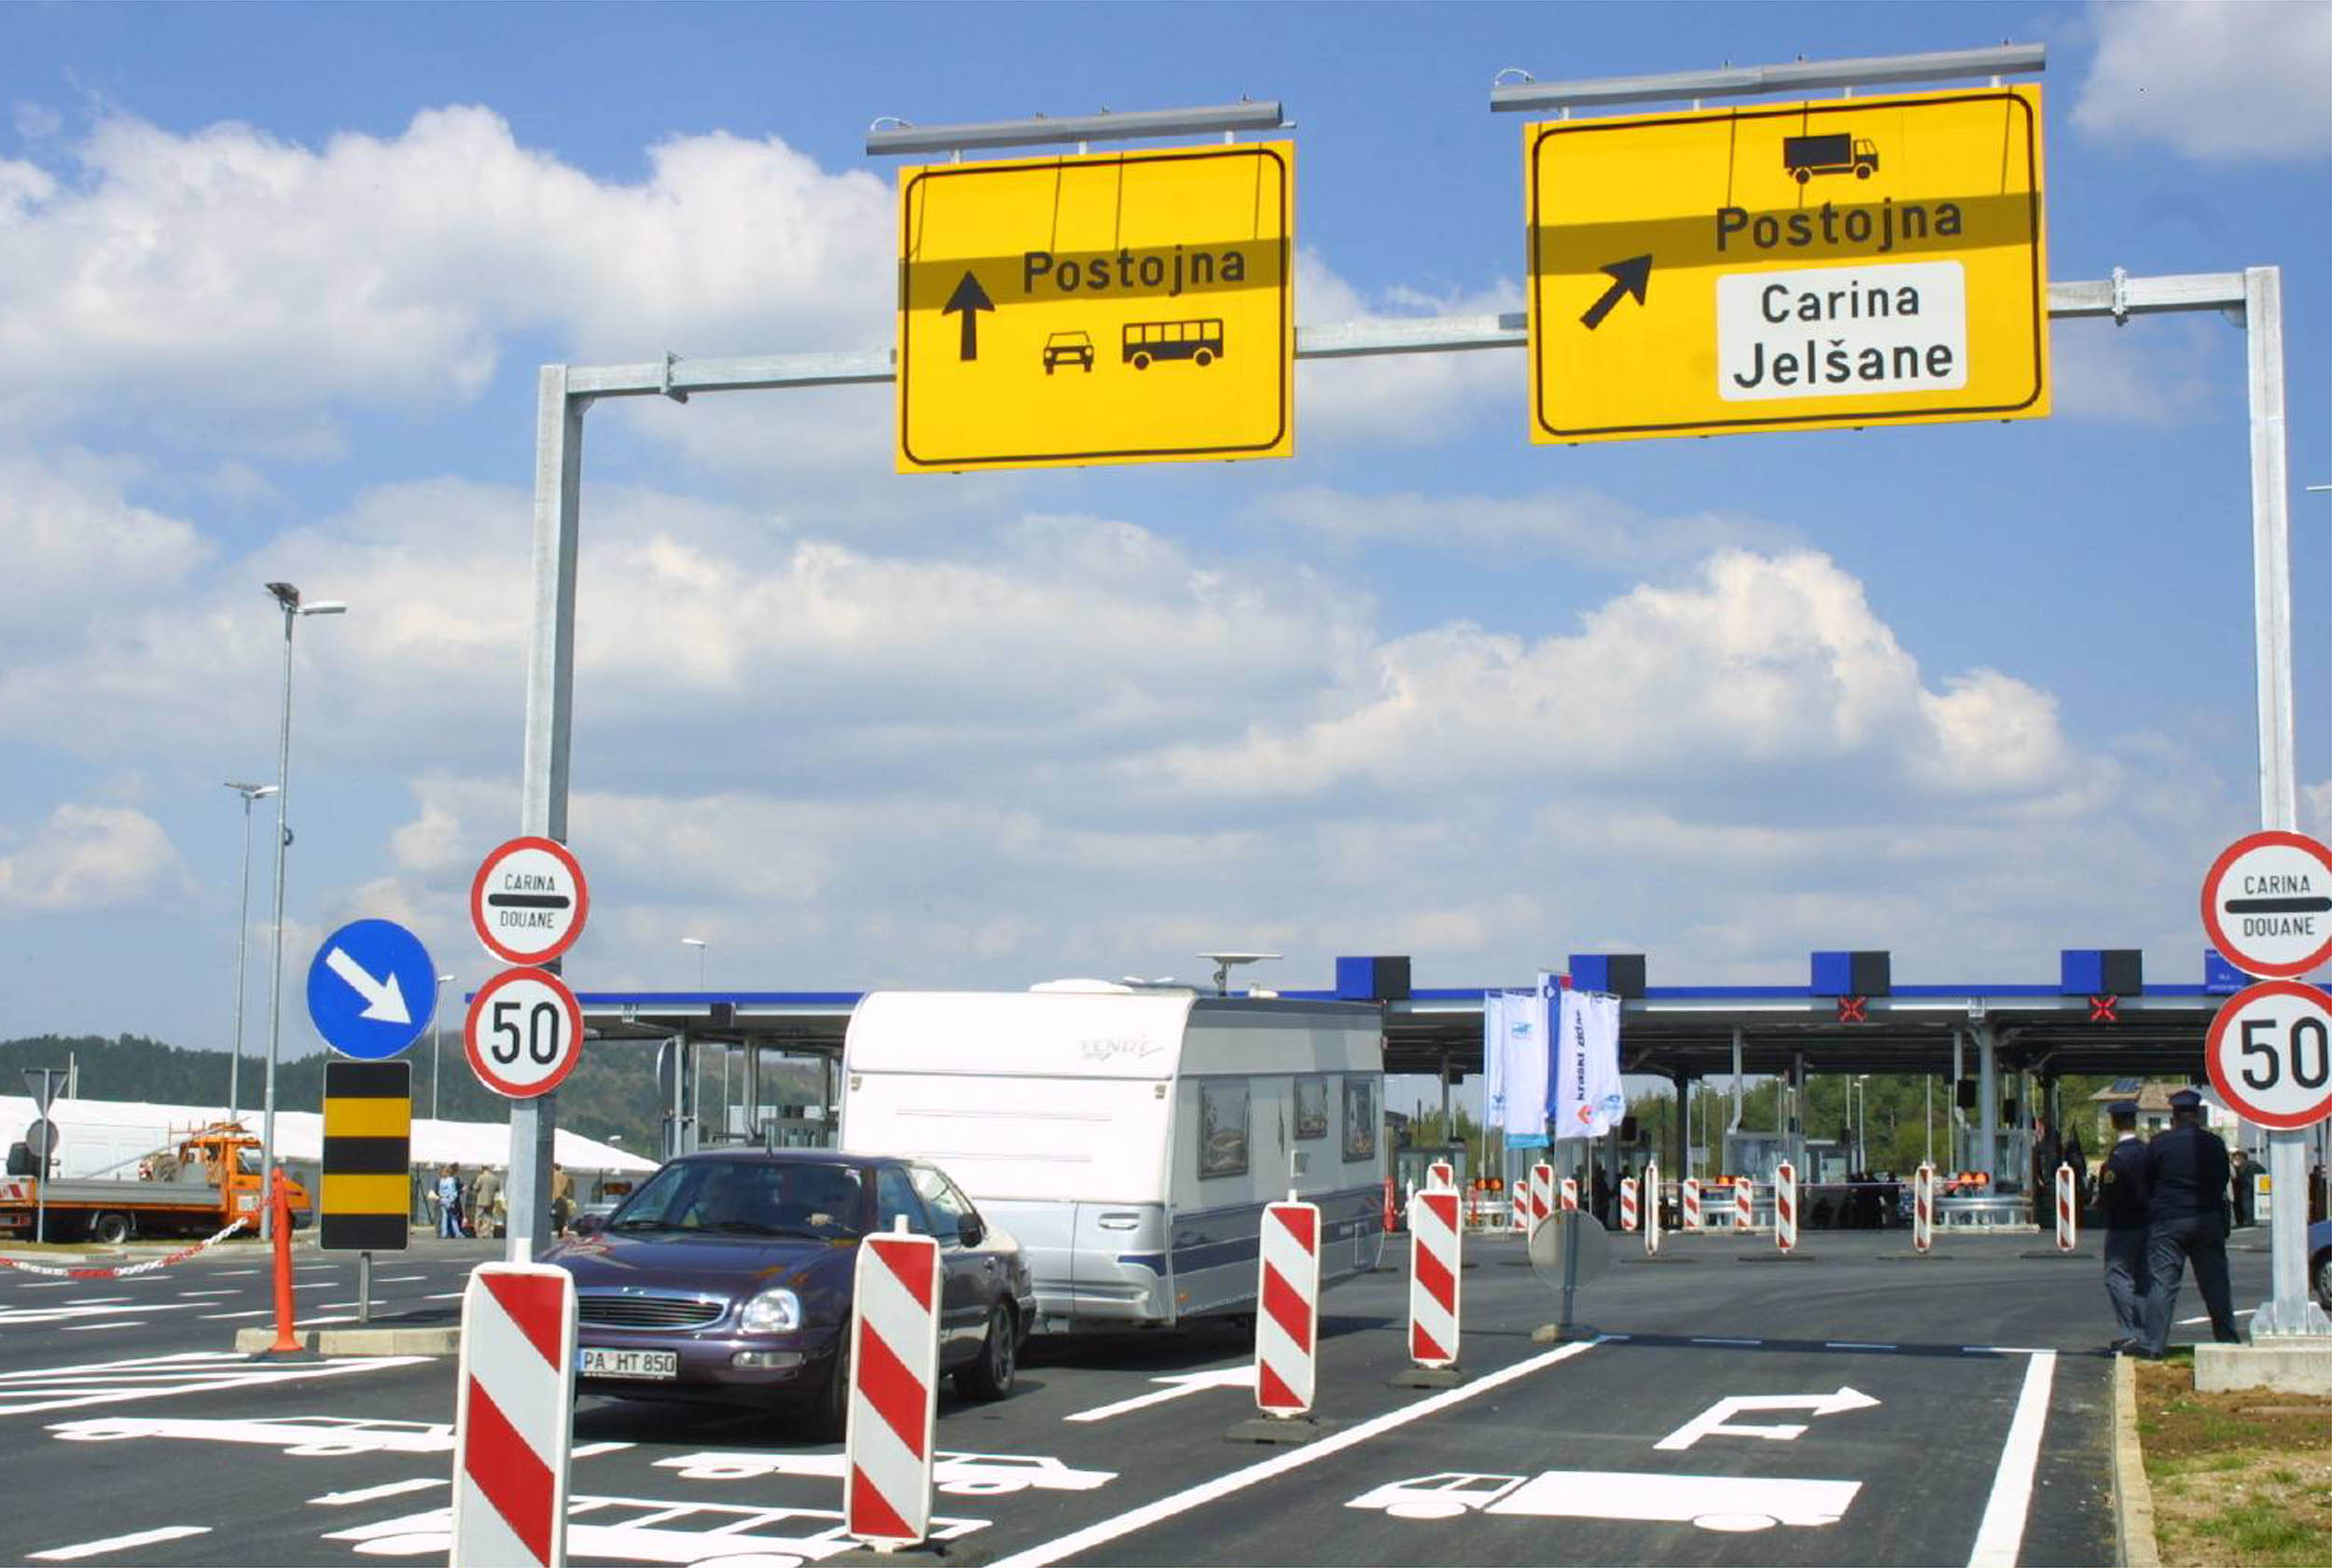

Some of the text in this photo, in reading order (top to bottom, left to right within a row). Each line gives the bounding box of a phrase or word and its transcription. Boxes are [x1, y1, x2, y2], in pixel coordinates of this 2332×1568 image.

[1716, 197, 1962, 253] Postojna
[1023, 244, 1245, 298] Postojna
[1761, 280, 1920, 324] Carina
[1733, 339, 1953, 389] Jelšane
[505, 873, 556, 892] CARINA
[2243, 875, 2311, 895] CARINA
[500, 910, 556, 929] DOUANE
[2242, 917, 2315, 937] DOUANE
[491, 1001, 560, 1064] 50
[2241, 1016, 2330, 1091] 50
[584, 1352, 675, 1372] PA HT 850
